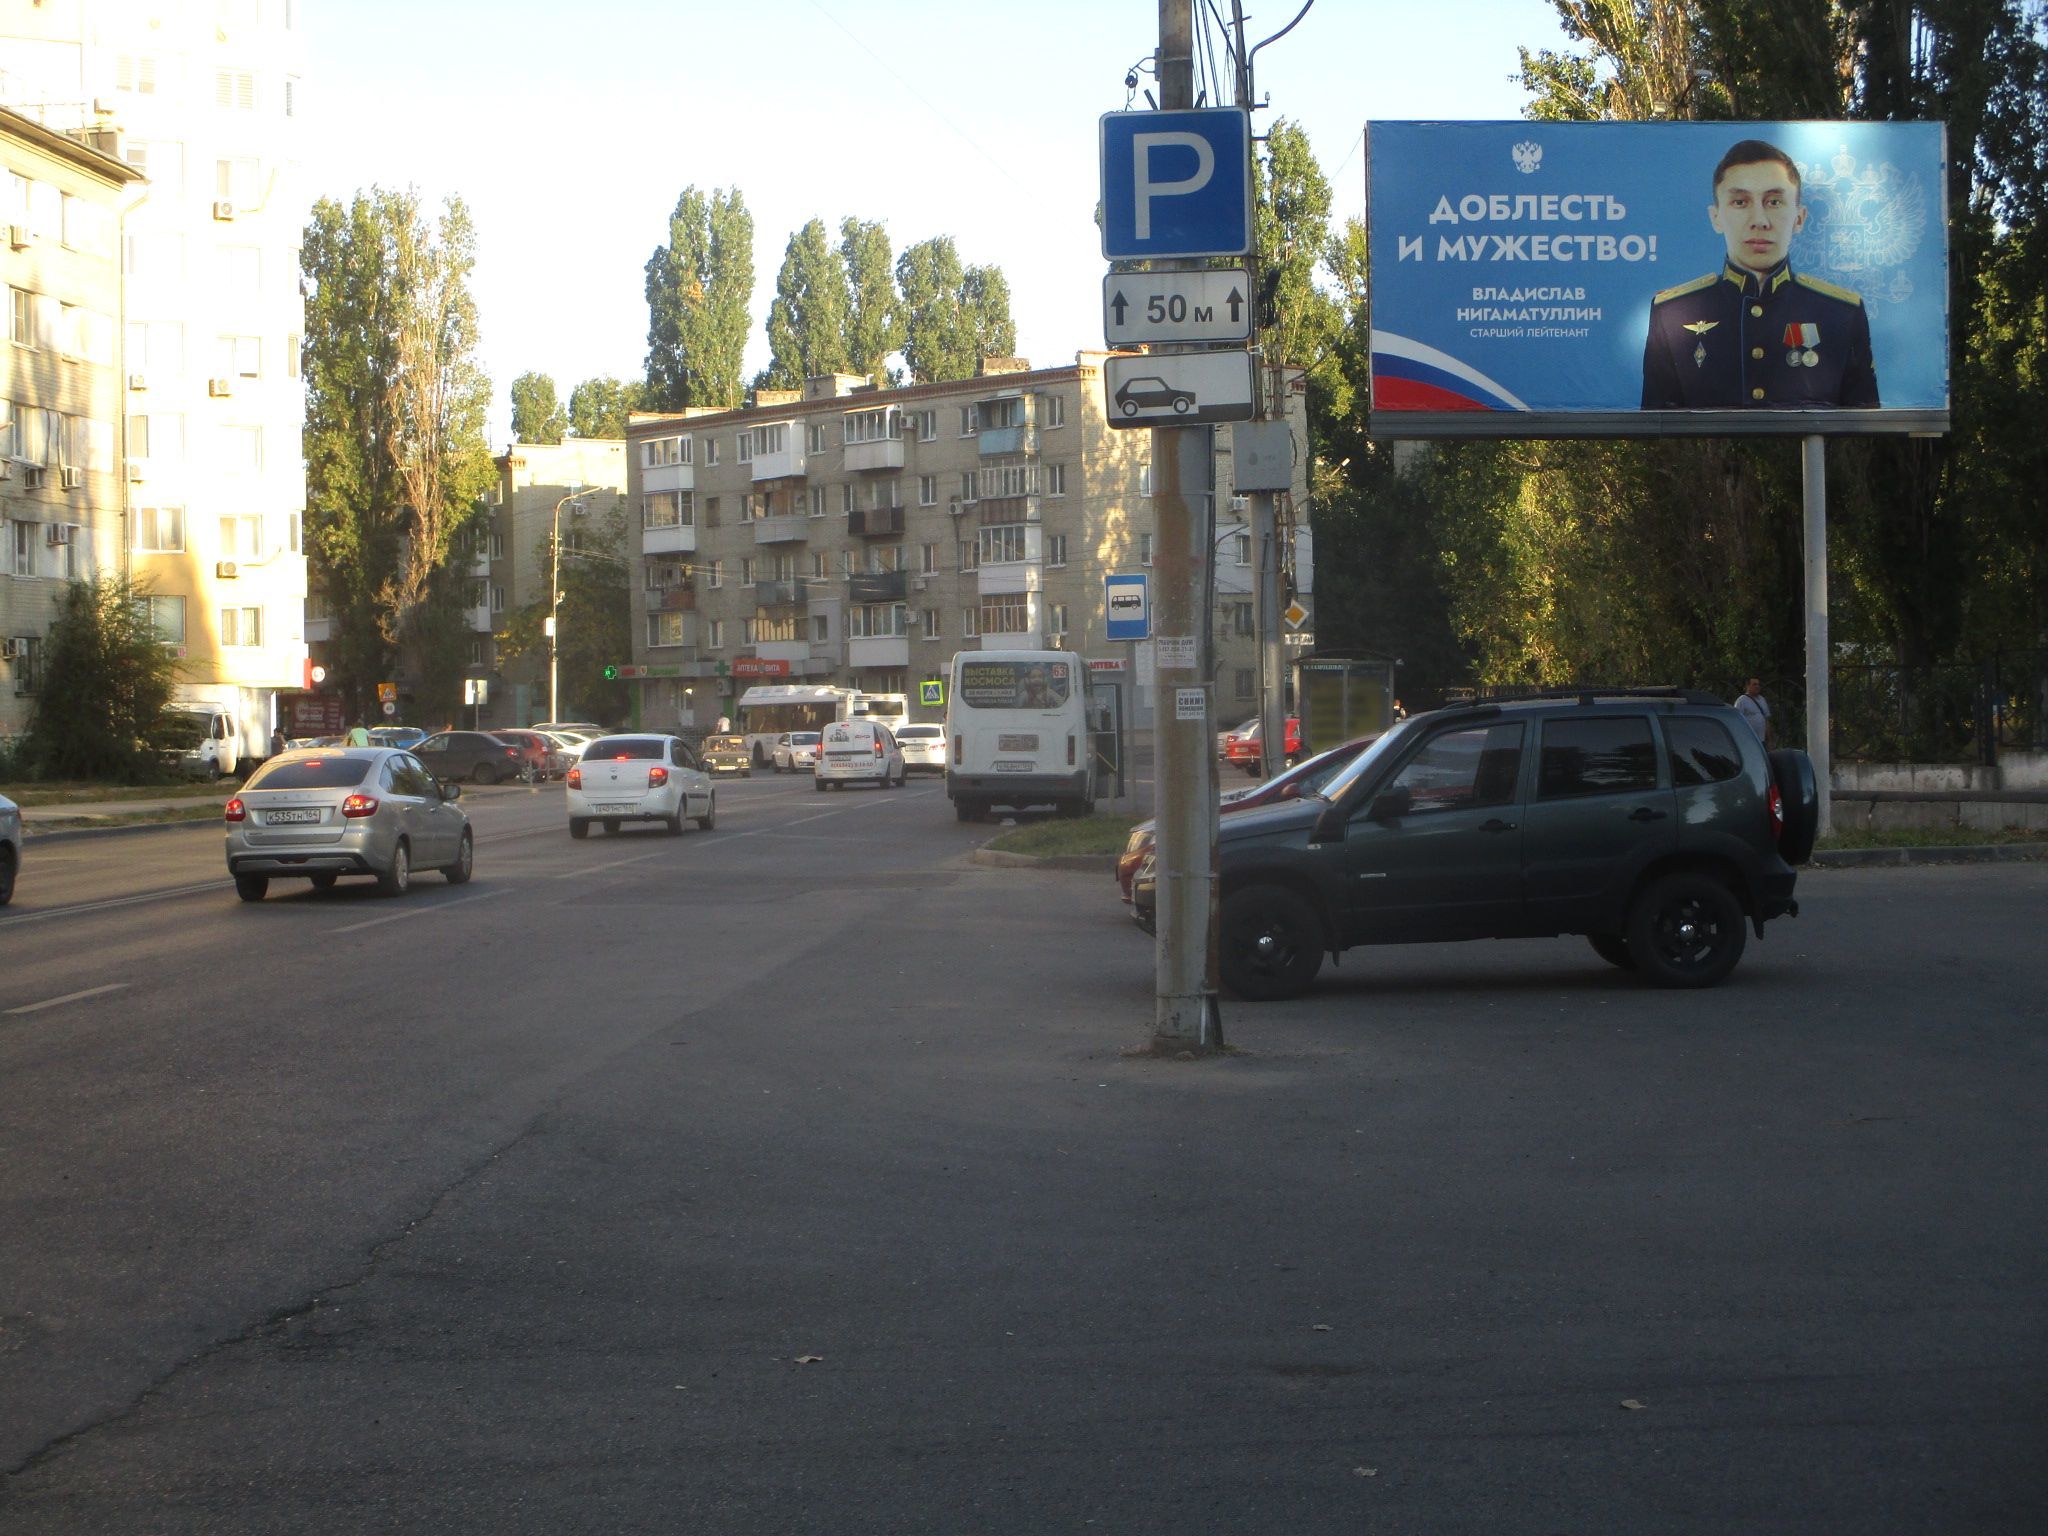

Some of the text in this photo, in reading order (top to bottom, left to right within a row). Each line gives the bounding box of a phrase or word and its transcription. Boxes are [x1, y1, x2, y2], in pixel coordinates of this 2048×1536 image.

[1133, 131, 1215, 240] P
[1429, 194, 1626, 225] ДОБЛЕСТЬ
[1398, 235, 1657, 262] И МУЖЕСТВО!
[1472, 287, 1586, 302] ВЛАДИСЛАВ
[1147, 294, 1213, 324] 50 м
[1457, 307, 1602, 321] НИГАМАТУЛЛИН
[1470, 327, 1589, 338] СТАРШИЙ ЛЕЙТЕНАНТ
[736, 664, 781, 673] АПТЕКА ВИТА
[1087, 661, 1119, 669] АПТЕКА
[965, 667, 1015, 677] ВЫСТАВКА
[1054, 667, 1066, 677] 63
[965, 677, 1016, 686] КОСМОСА
[268, 811, 303, 822] К535ТН
